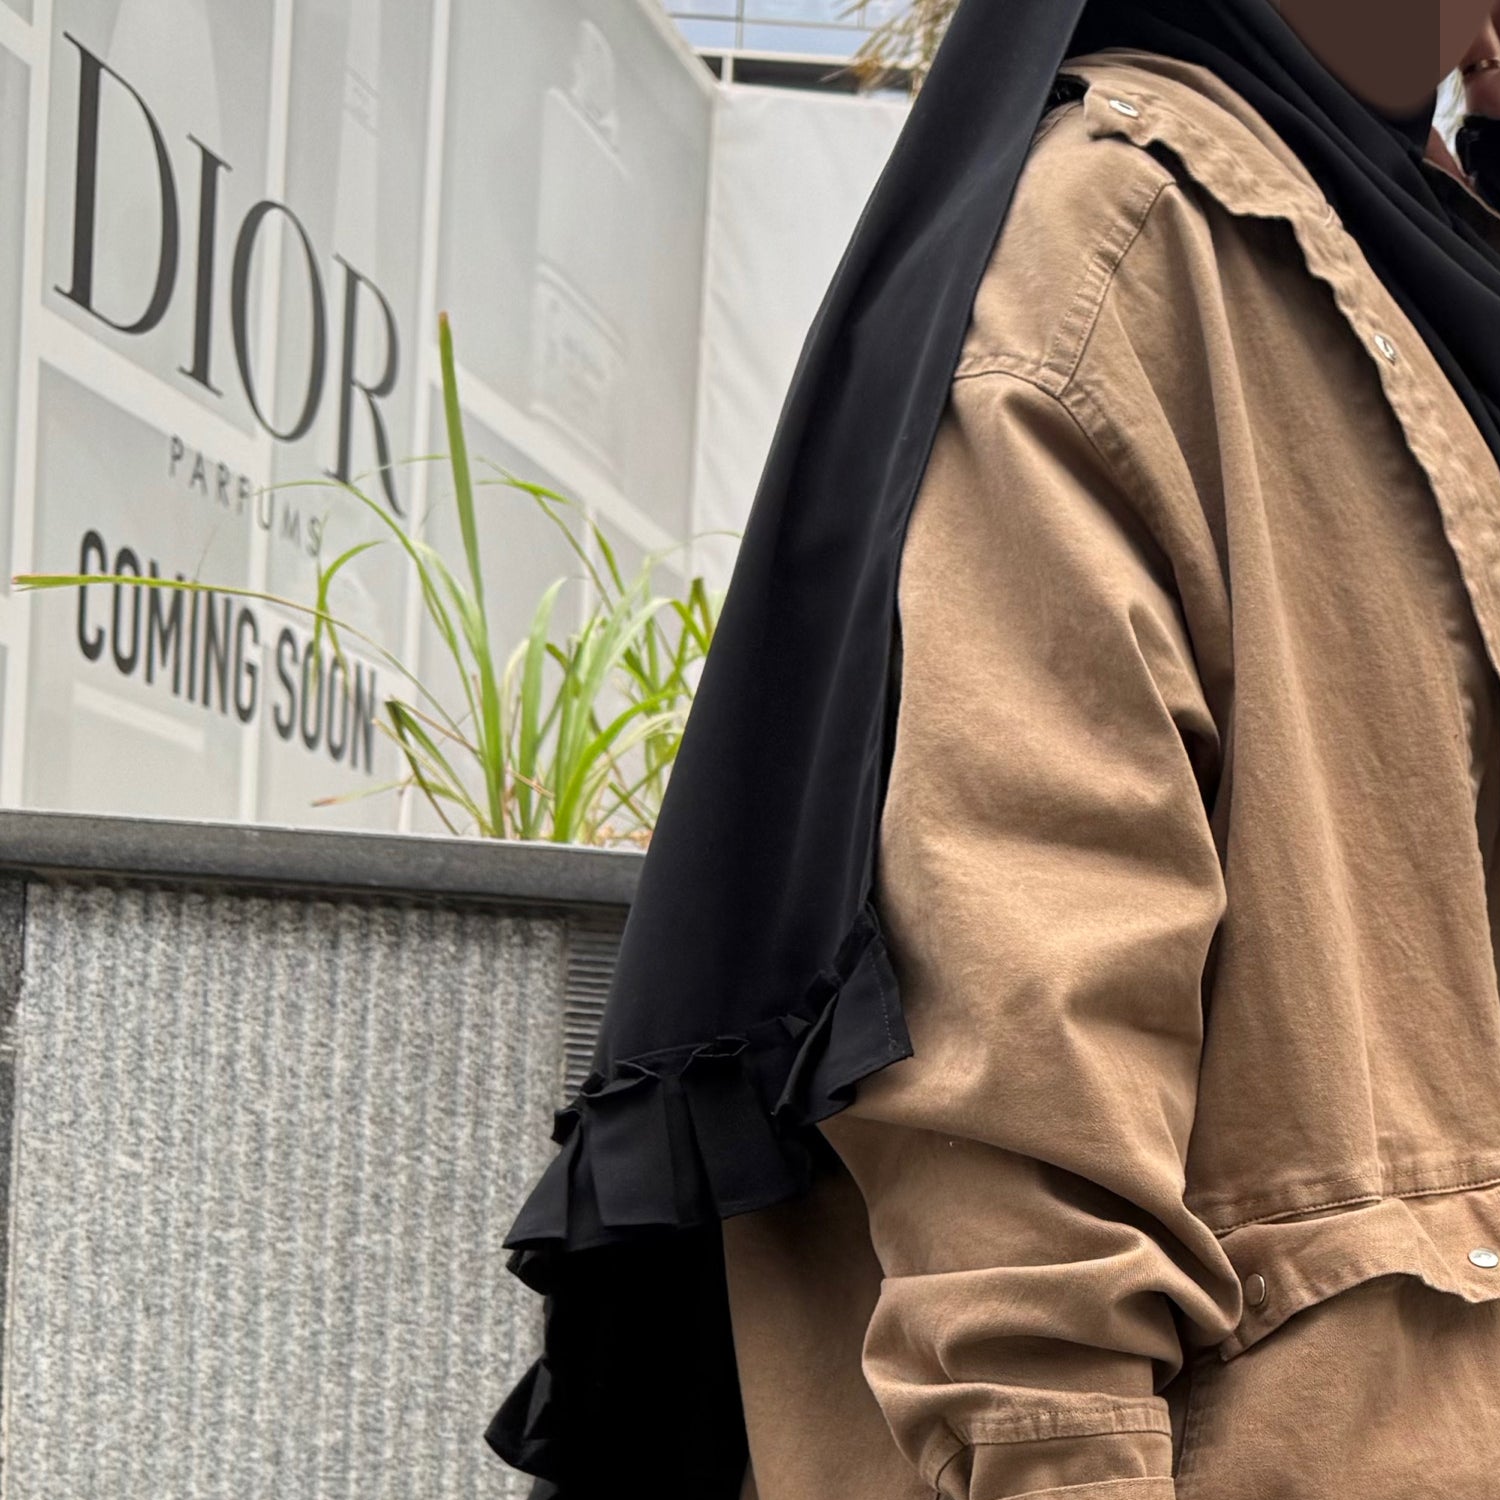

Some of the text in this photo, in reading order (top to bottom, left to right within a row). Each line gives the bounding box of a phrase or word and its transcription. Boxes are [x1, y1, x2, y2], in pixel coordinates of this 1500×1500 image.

[53, 31, 406, 518] DIOR
[169, 436, 323, 557] PARFUMS
[78, 529, 377, 774] COMING SOON
